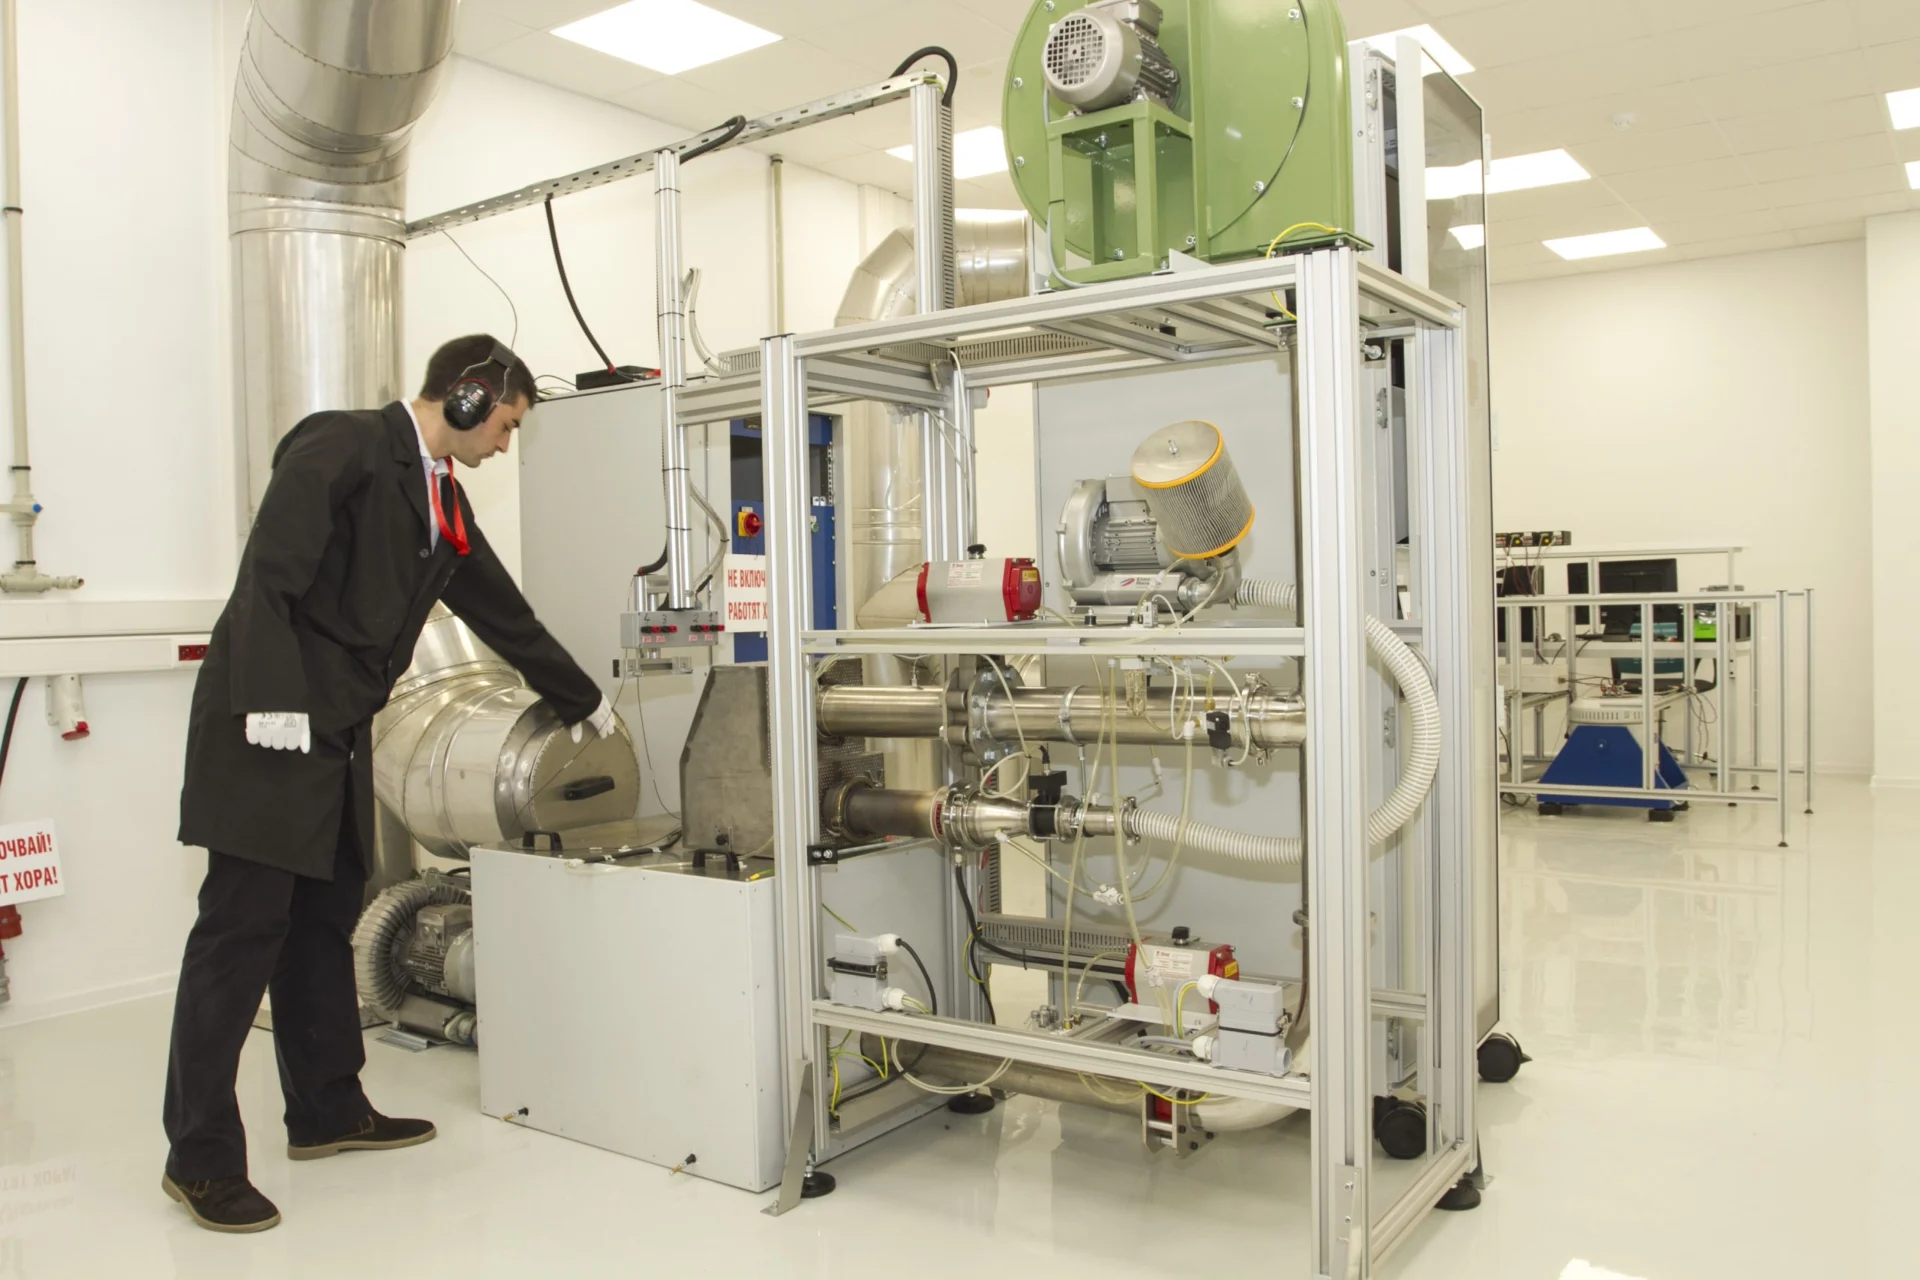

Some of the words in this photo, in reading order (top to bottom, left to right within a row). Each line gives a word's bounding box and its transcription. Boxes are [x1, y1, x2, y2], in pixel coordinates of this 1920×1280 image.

[728, 569, 737, 588] НЕ
[728, 601, 760, 620] РАБОТЯТ
[13, 866, 58, 892] ХОРА!
